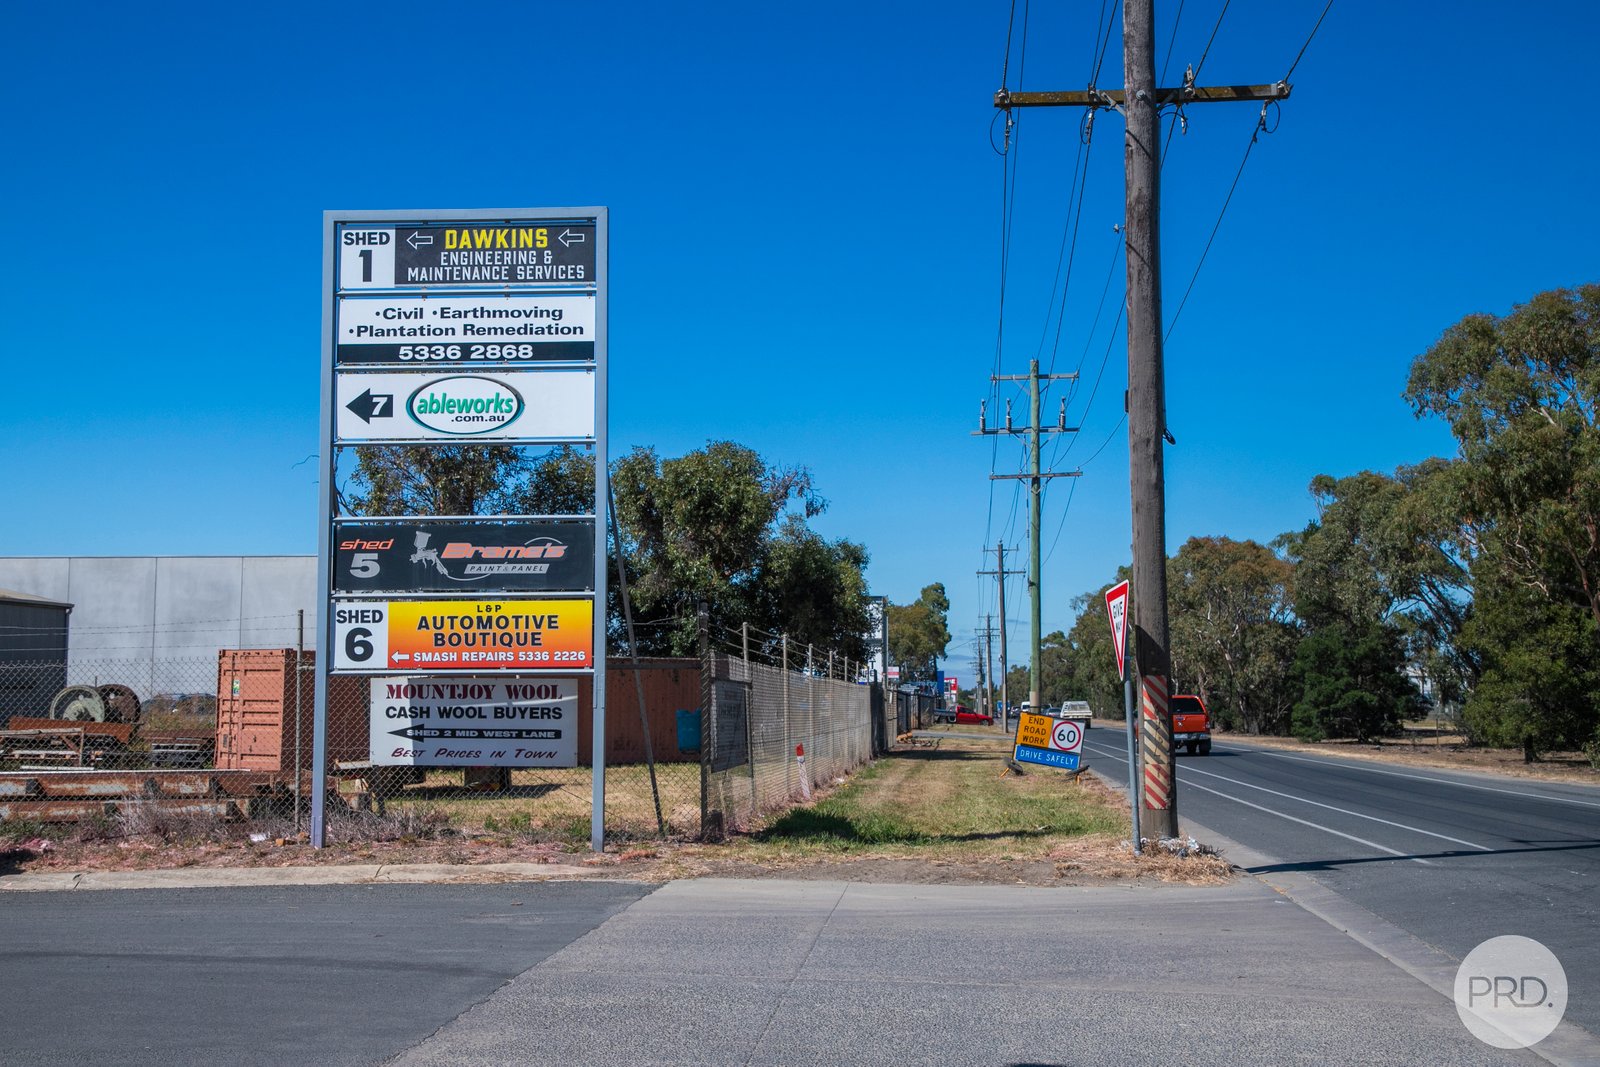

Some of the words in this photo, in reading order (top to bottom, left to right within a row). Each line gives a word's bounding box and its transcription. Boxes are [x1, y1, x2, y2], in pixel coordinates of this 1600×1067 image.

[343, 231, 391, 246] SHED
[444, 228, 549, 250] DAWKINS
[440, 250, 537, 266] ENGINEERING
[543, 250, 553, 265] &
[358, 249, 373, 283] 1
[407, 266, 509, 282] MAINTENANCE
[516, 265, 586, 280] SERVICES
[382, 307, 424, 320] Civil
[439, 306, 564, 320] Earthmoving
[356, 324, 457, 338] Plantation
[462, 323, 585, 336] Remediation
[398, 344, 462, 360] 5336
[470, 344, 534, 359] 2868
[371, 397, 388, 416] 7
[416, 391, 514, 414] ableworks
[450, 414, 506, 423] .com.au
[339, 538, 395, 550] shed
[349, 552, 381, 579] 5
[335, 609, 384, 624] SHED
[416, 614, 560, 631] AUTOMOTIVE
[344, 626, 374, 662] 6
[433, 631, 543, 648] BOUTIQUE
[413, 651, 458, 662] SMASH
[461, 651, 515, 662] REPAIRS
[518, 651, 550, 661] 5336
[553, 650, 586, 661] 2226
[385, 684, 497, 700] MOUNTJOY
[504, 684, 564, 700] WOOL
[384, 706, 431, 719] CASH
[437, 706, 488, 719] WOOL
[493, 706, 563, 720] BUYERS
[1028, 716, 1045, 726] END
[405, 729, 440, 737] SHED
[443, 729, 452, 737] 2
[455, 730, 479, 738] MID
[482, 730, 518, 738] WEST
[521, 731, 556, 739] LANE
[1023, 725, 1047, 736] ROAD
[1057, 729, 1076, 743] 60
[1022, 735, 1046, 745] WORK
[1020, 749, 1043, 760] DRIVE
[1045, 753, 1075, 766] SAFELY
